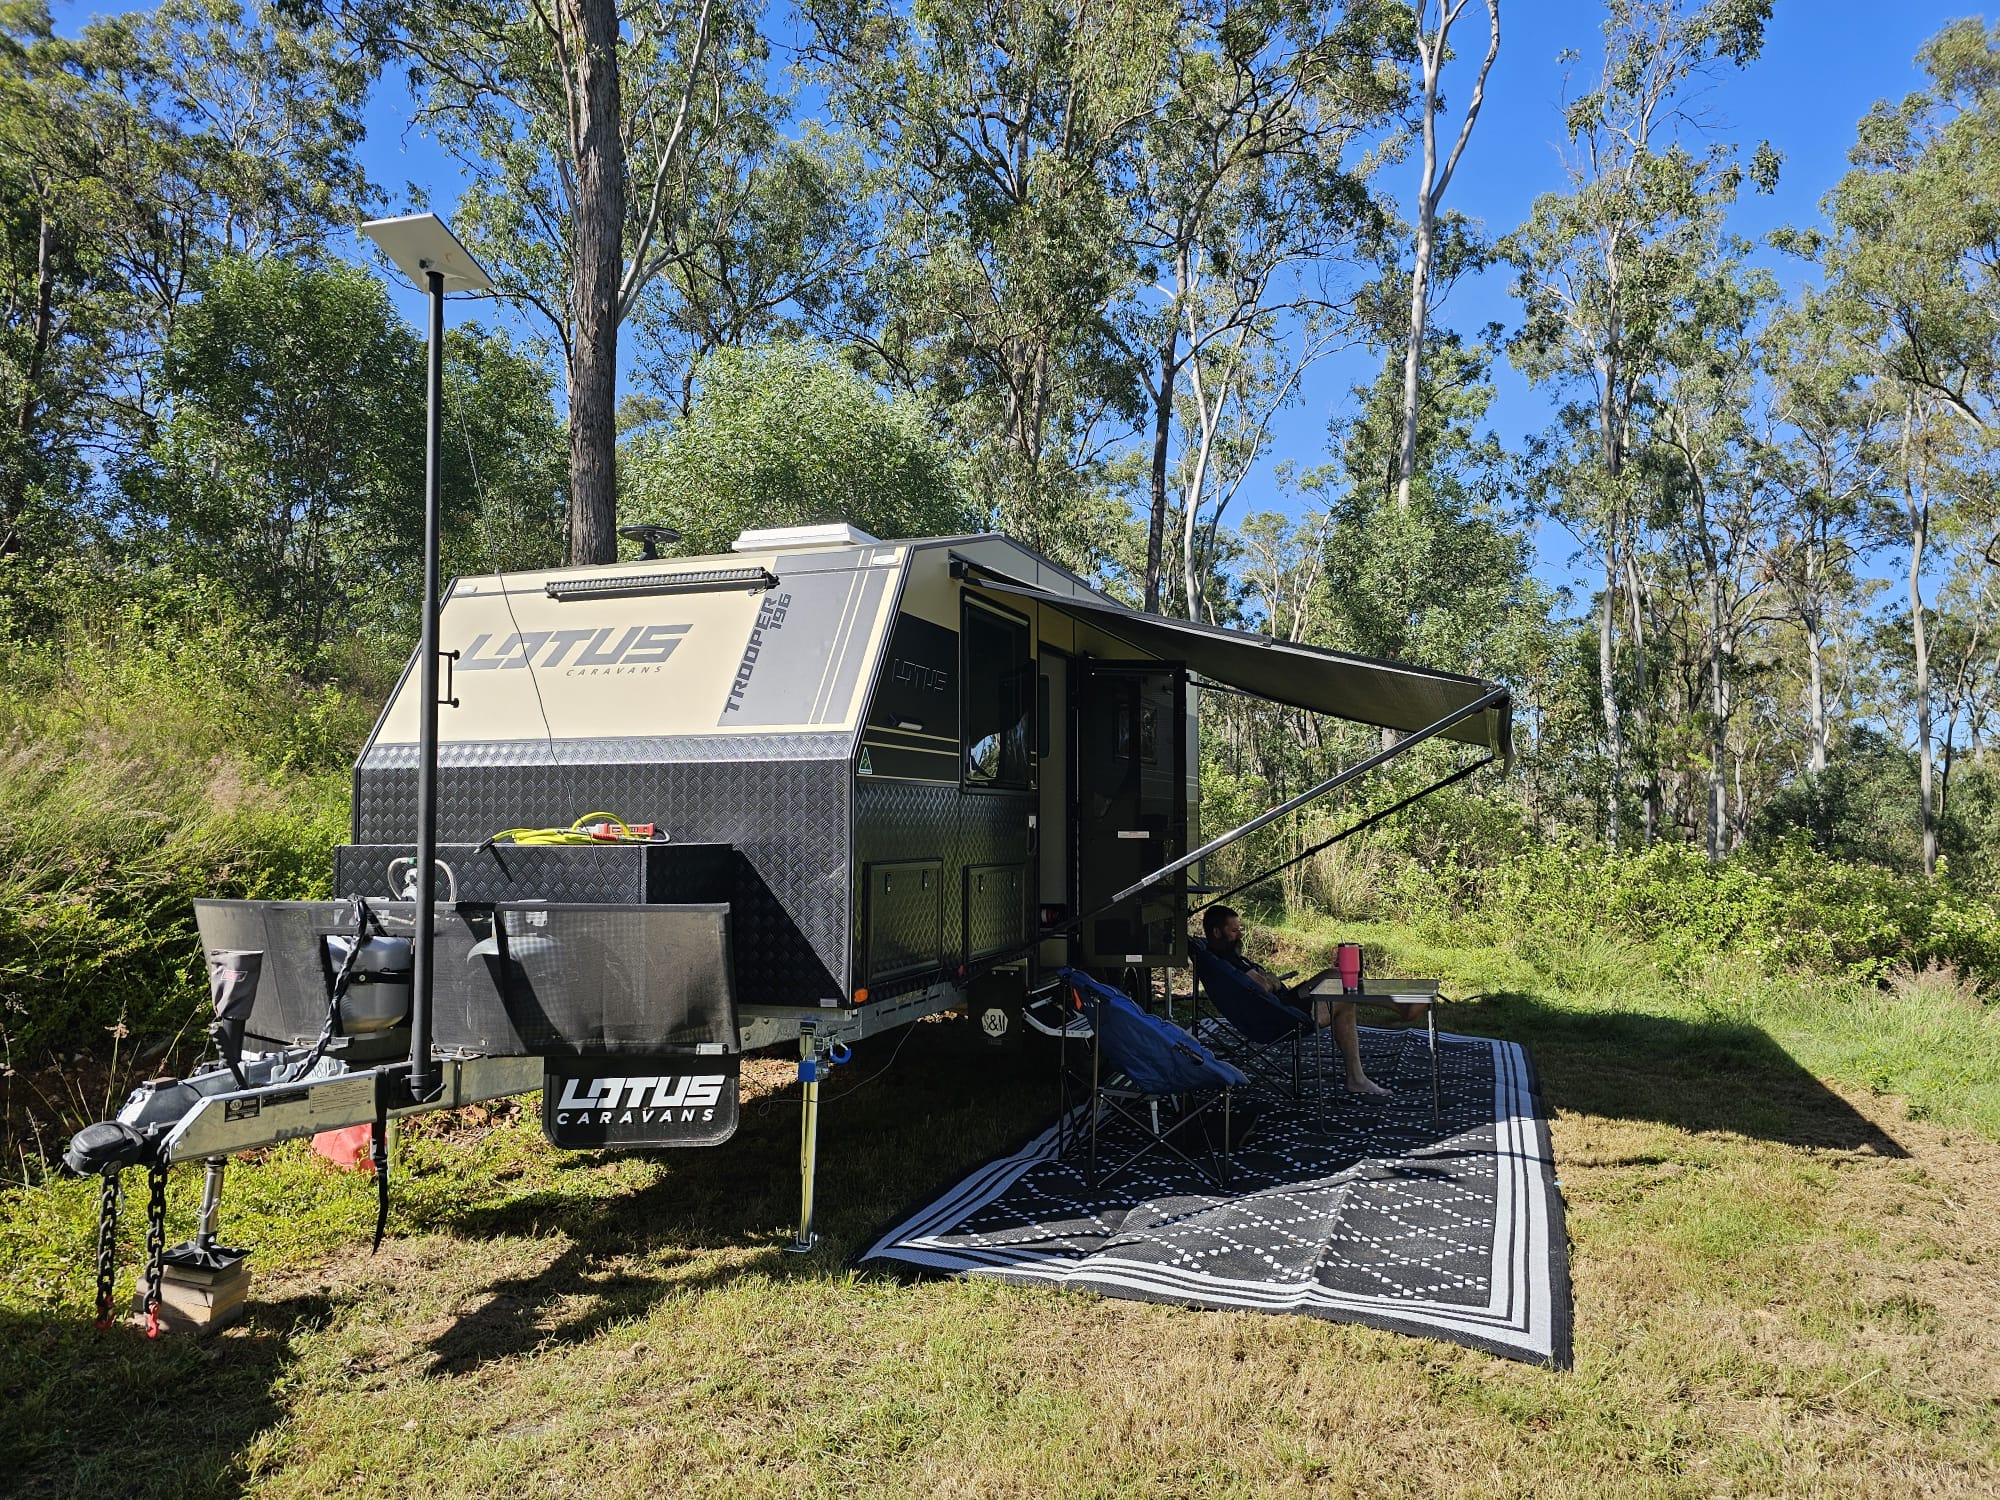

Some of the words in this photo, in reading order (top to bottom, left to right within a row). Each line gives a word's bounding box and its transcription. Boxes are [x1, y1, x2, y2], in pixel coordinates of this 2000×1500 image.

[769, 593, 792, 630] 196
[453, 623, 694, 671] LOTUS
[724, 597, 777, 713] TROOPER
[566, 665, 662, 677] CARAVANS
[891, 658, 949, 694] LOTUS
[557, 1074, 726, 1110] LOTUS
[556, 1108, 715, 1125] CARAVANS
